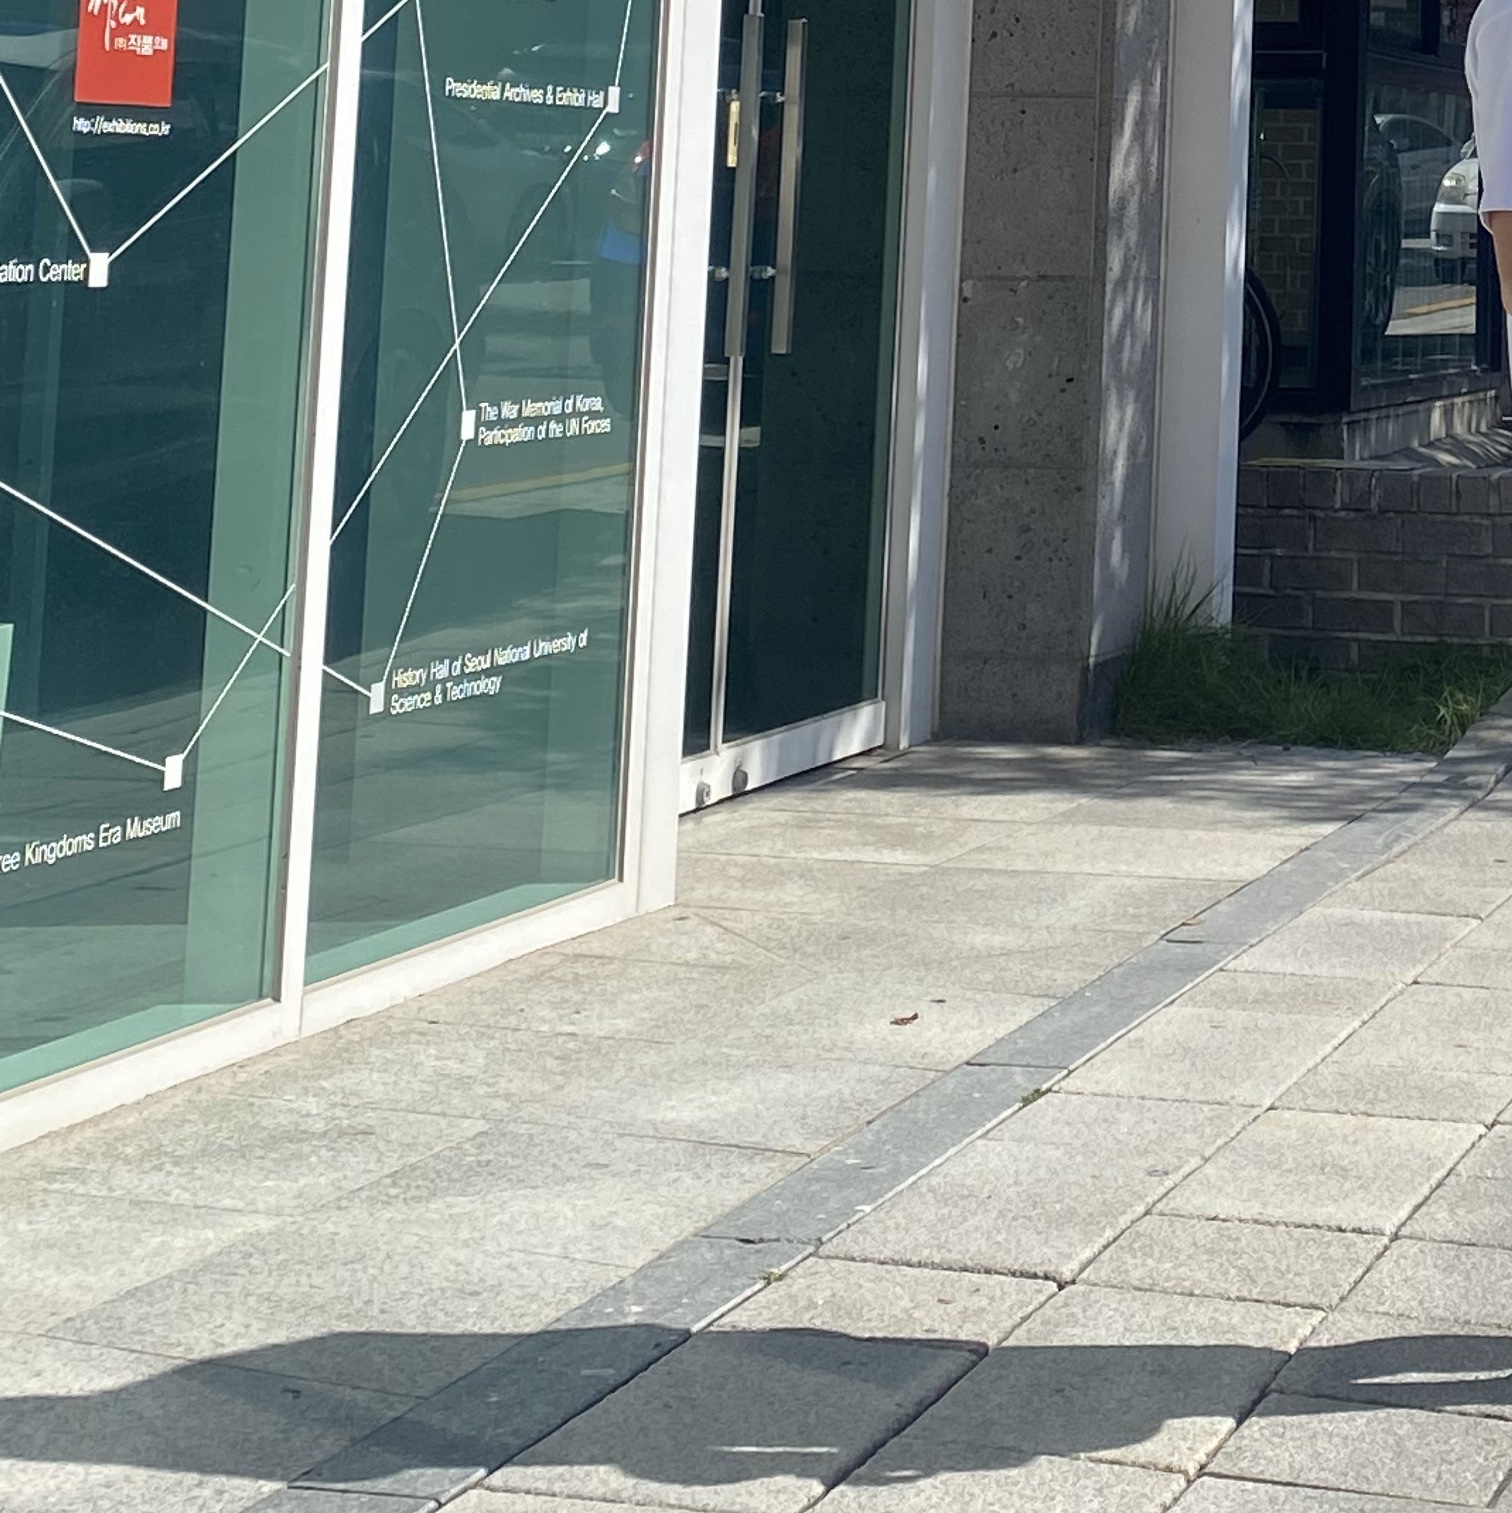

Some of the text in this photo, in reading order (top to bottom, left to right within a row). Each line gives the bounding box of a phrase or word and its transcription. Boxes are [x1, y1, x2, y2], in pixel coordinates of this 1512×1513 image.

[445, 77, 605, 108] Presidential Archives & Exhibit Hall
[38, 257, 87, 282] Center
[479, 402, 498, 422] The
[500, 399, 519, 419] War
[521, 395, 563, 417] Memorial
[564, 393, 575, 414] of
[478, 415, 612, 447] Participation of the UN Forces
[392, 627, 589, 689] History Hall of Seoul National University of
[390, 675, 503, 715] Science & Technology
[23, 830, 96, 868] Kingdoms
[98, 822, 122, 848] Era
[125, 809, 182, 841] Museum
